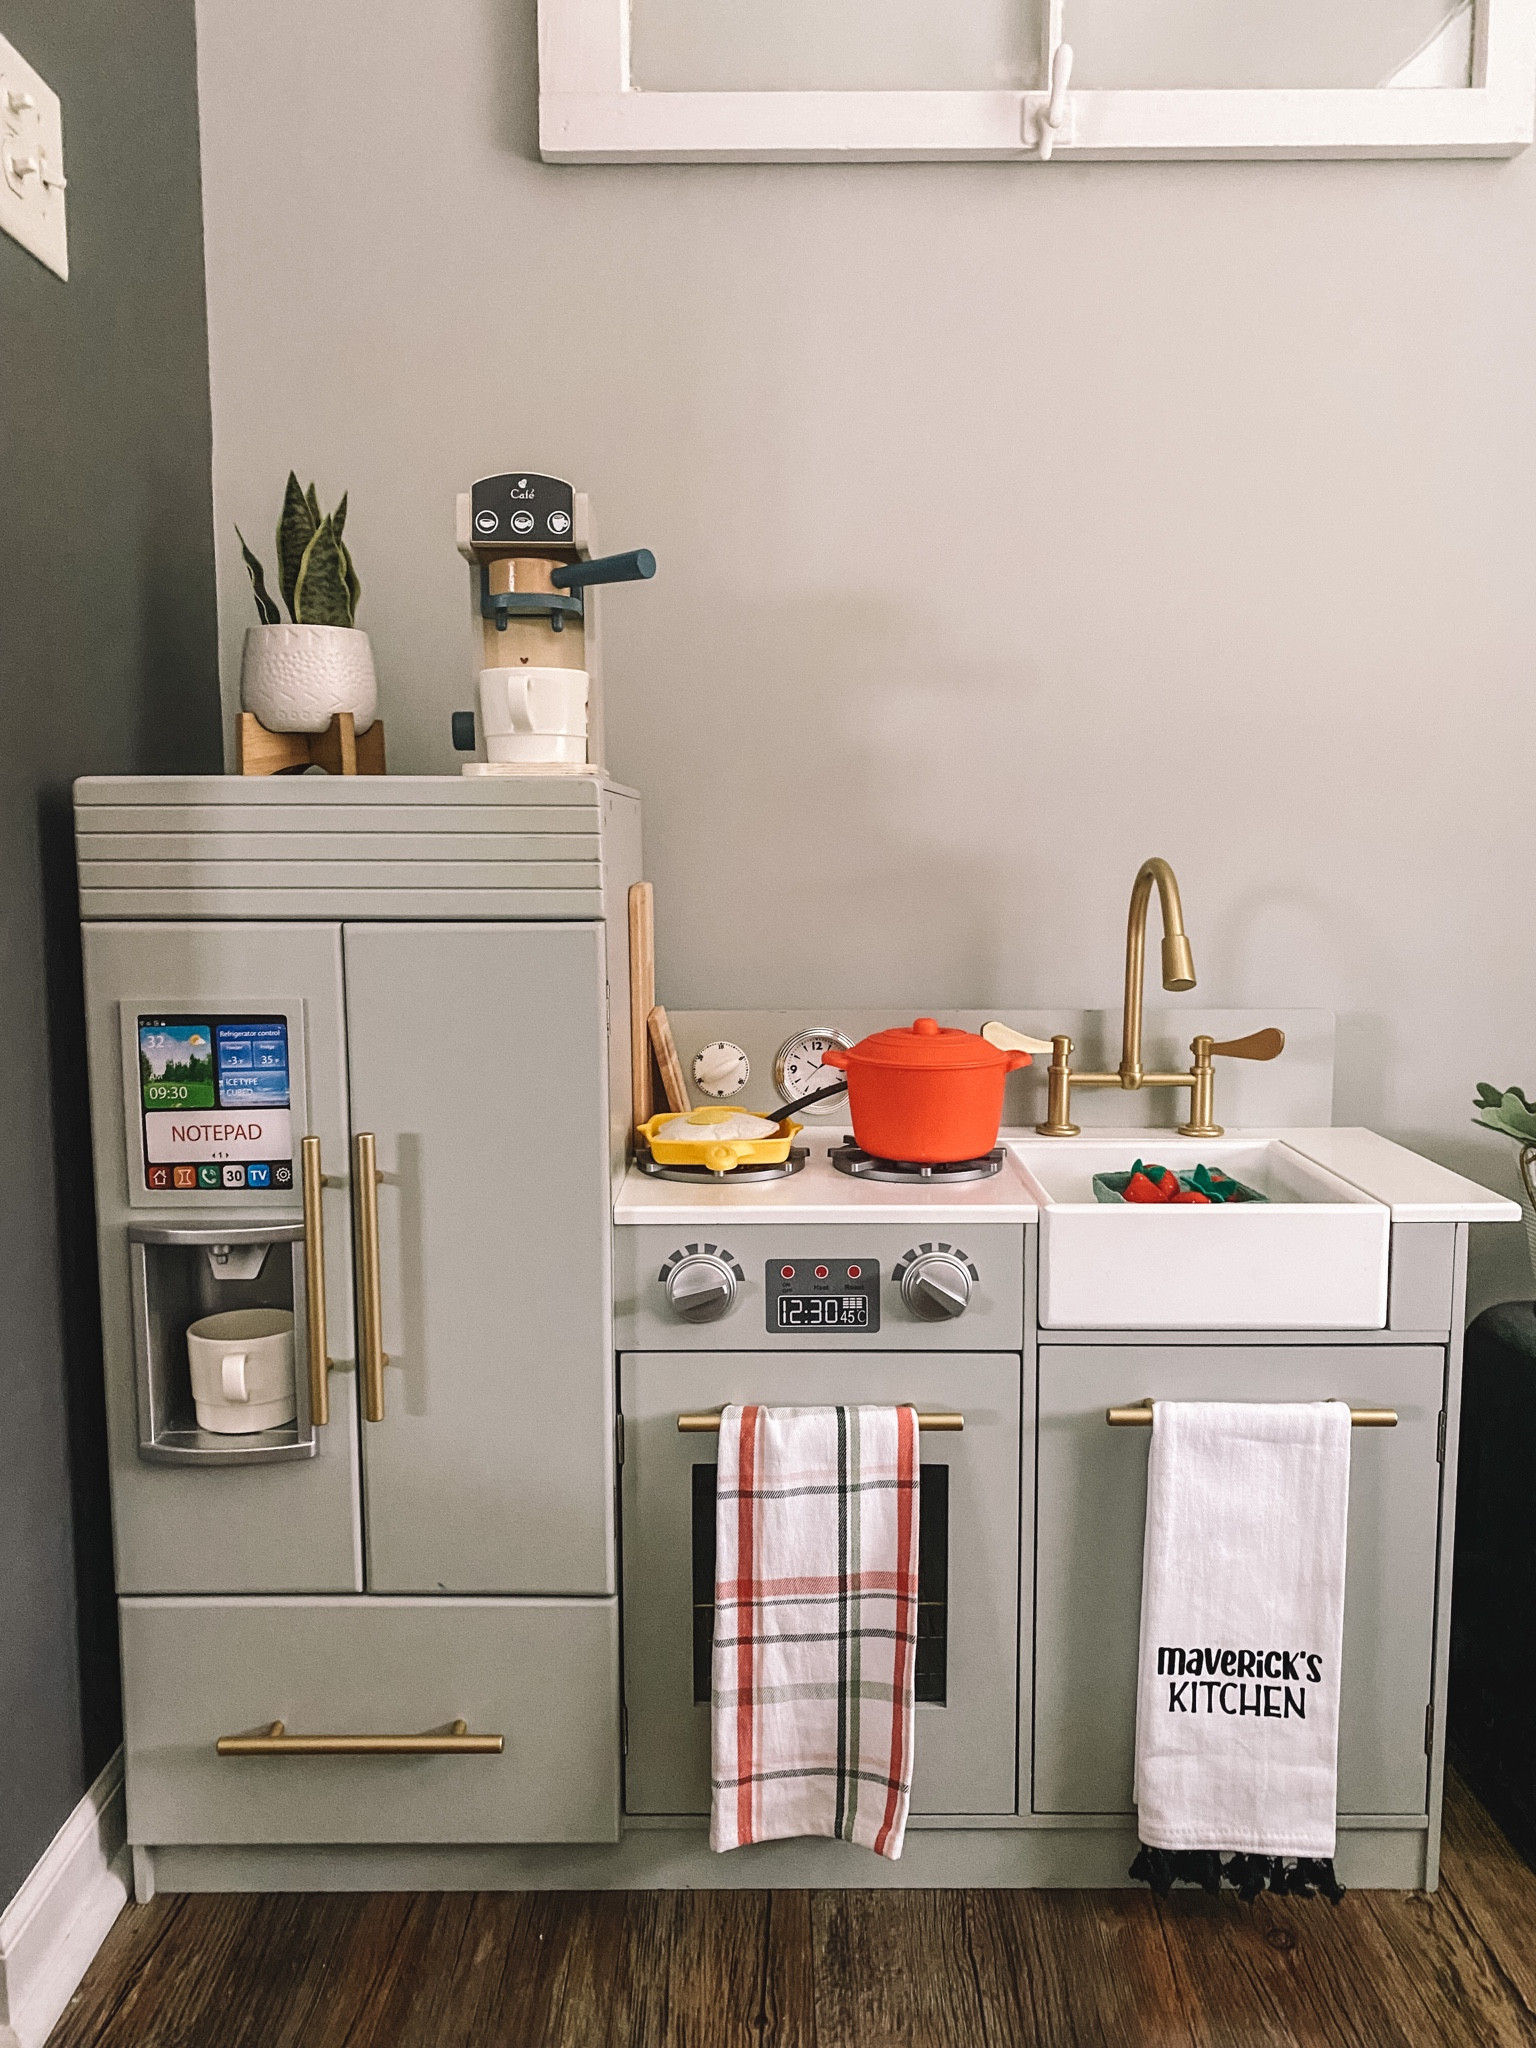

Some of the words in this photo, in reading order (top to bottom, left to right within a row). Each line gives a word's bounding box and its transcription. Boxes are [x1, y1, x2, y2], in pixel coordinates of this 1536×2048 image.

[510, 488, 535, 499] Café
[219, 1030, 257, 1039] Refrigerator
[147, 1035, 165, 1048] 32
[811, 1041, 823, 1051] 12
[261, 1055, 273, 1065] 35
[789, 1064, 798, 1074] 9
[238, 1077, 259, 1086] TYPE
[149, 1086, 188, 1100] 09:30
[171, 1123, 262, 1142] NOTEPAD
[226, 1170, 242, 1182] 30
[250, 1169, 268, 1181] TV
[782, 1299, 838, 1324] 12:30
[1168, 1681, 1306, 1719] KITCHEN
